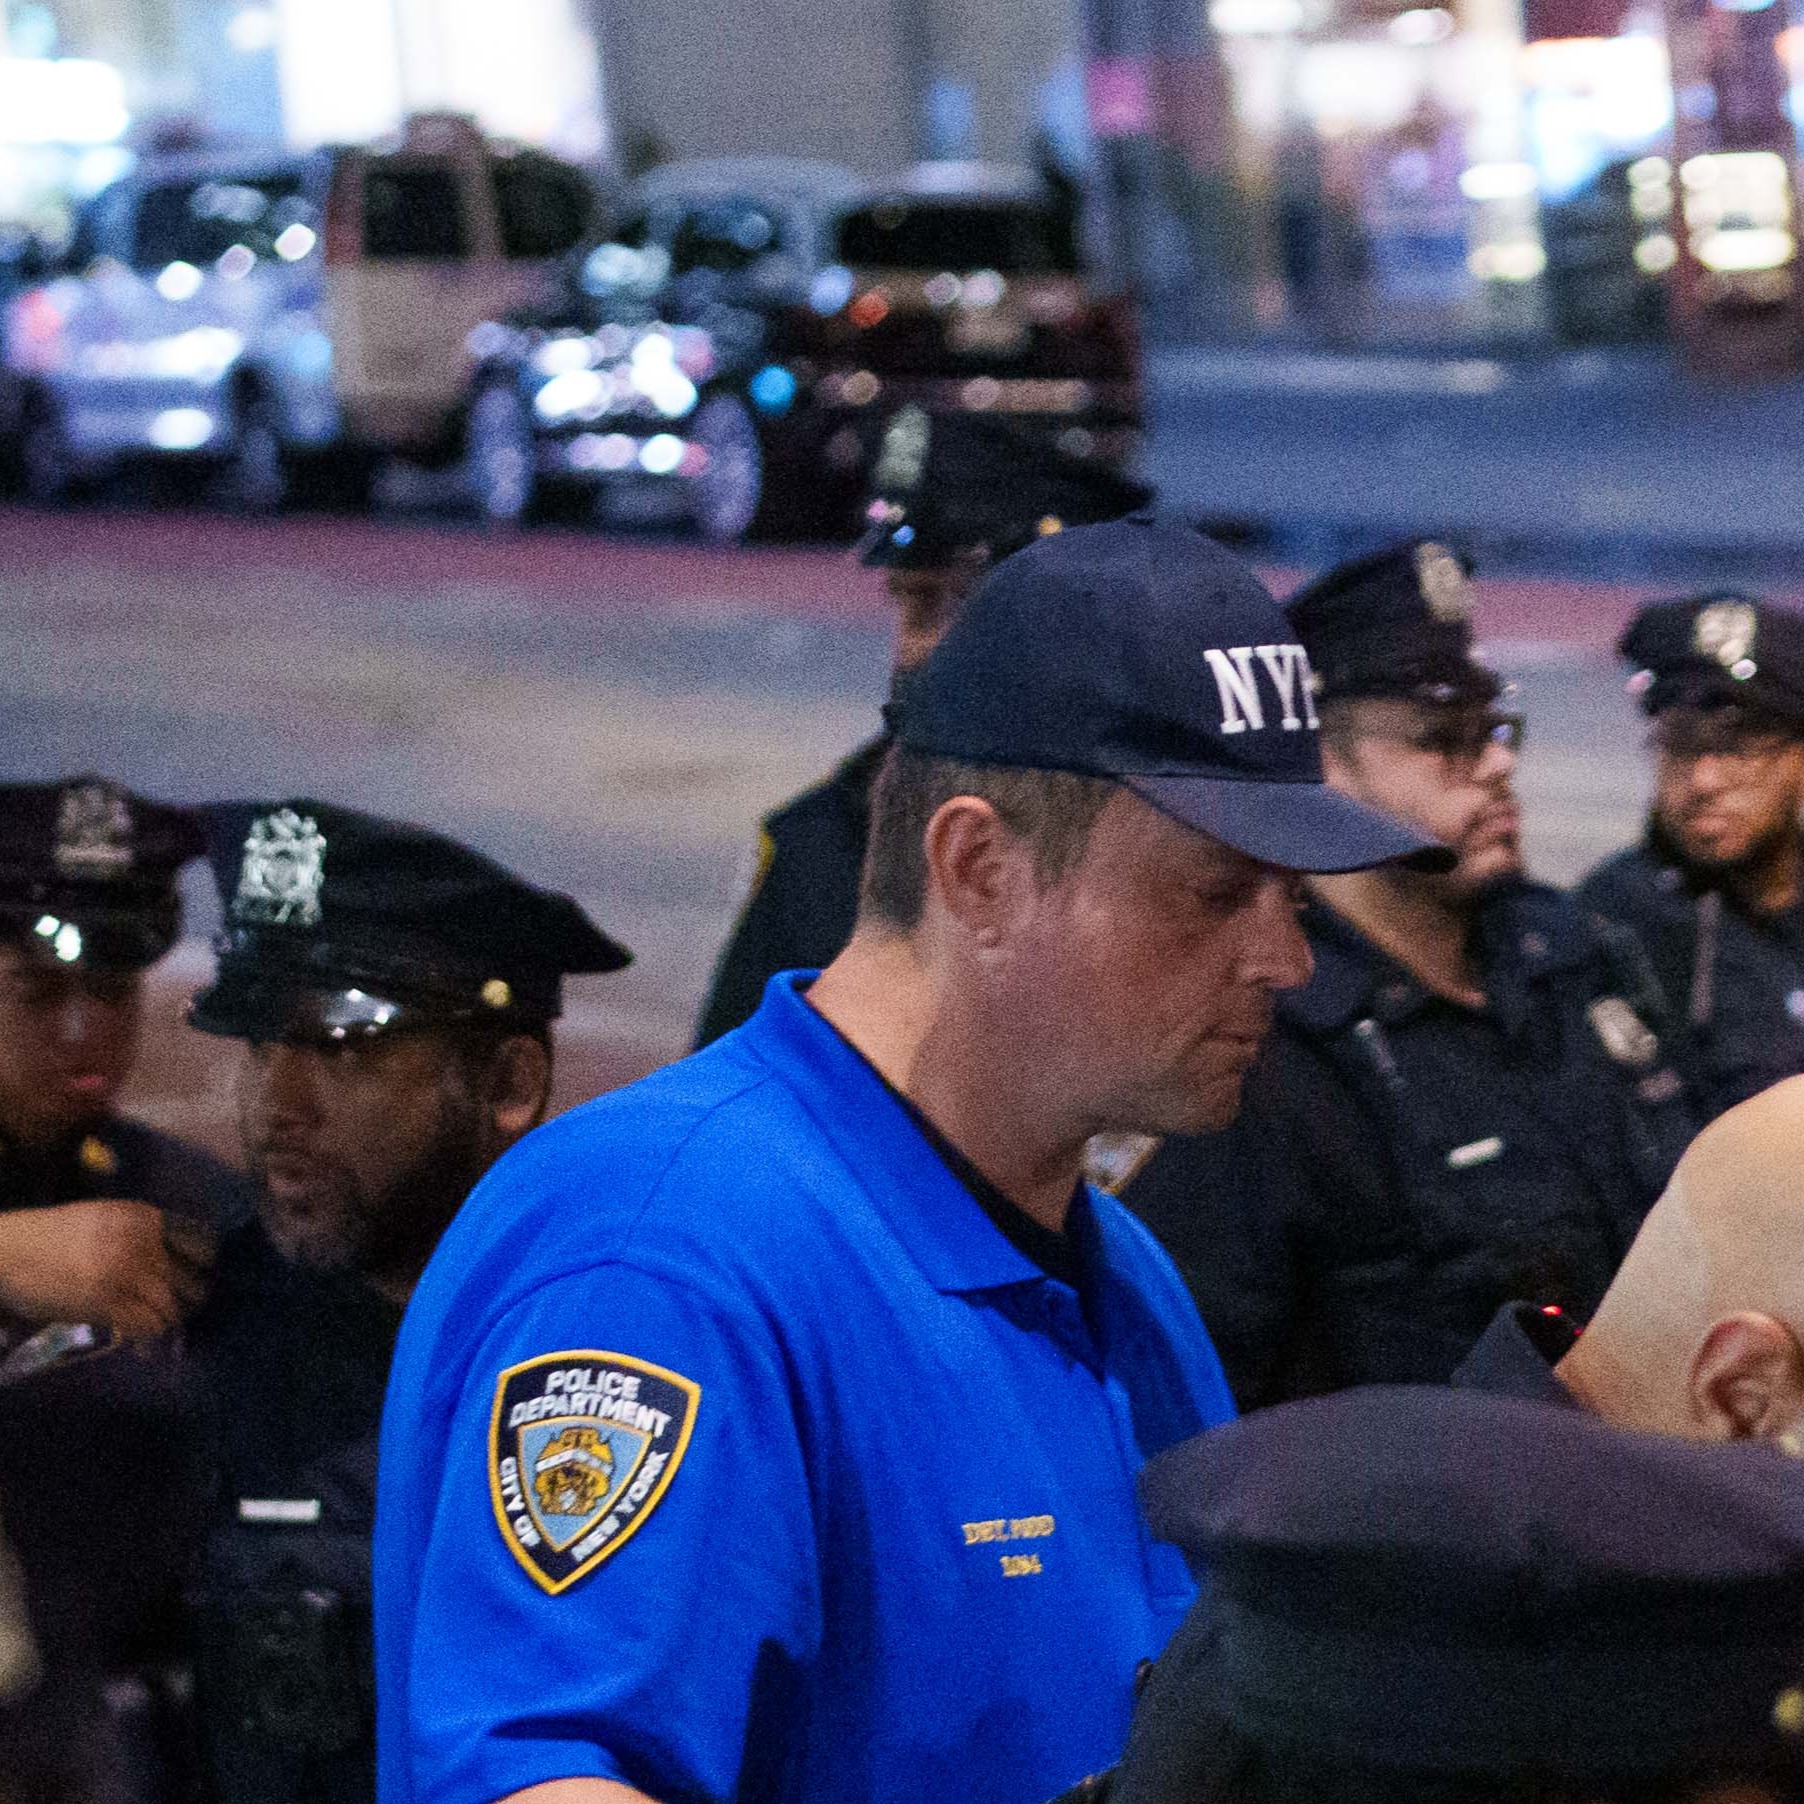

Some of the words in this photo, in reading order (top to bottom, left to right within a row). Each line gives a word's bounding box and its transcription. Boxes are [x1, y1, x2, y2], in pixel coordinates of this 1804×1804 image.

[508, 1391, 673, 1439] DEPARTMENT
[545, 1368, 641, 1402] POLICE
[500, 1456, 526, 1513] CITY
[513, 1514, 541, 1548] OF
[570, 1514, 621, 1563] NEW
[613, 1450, 671, 1515] YORK
